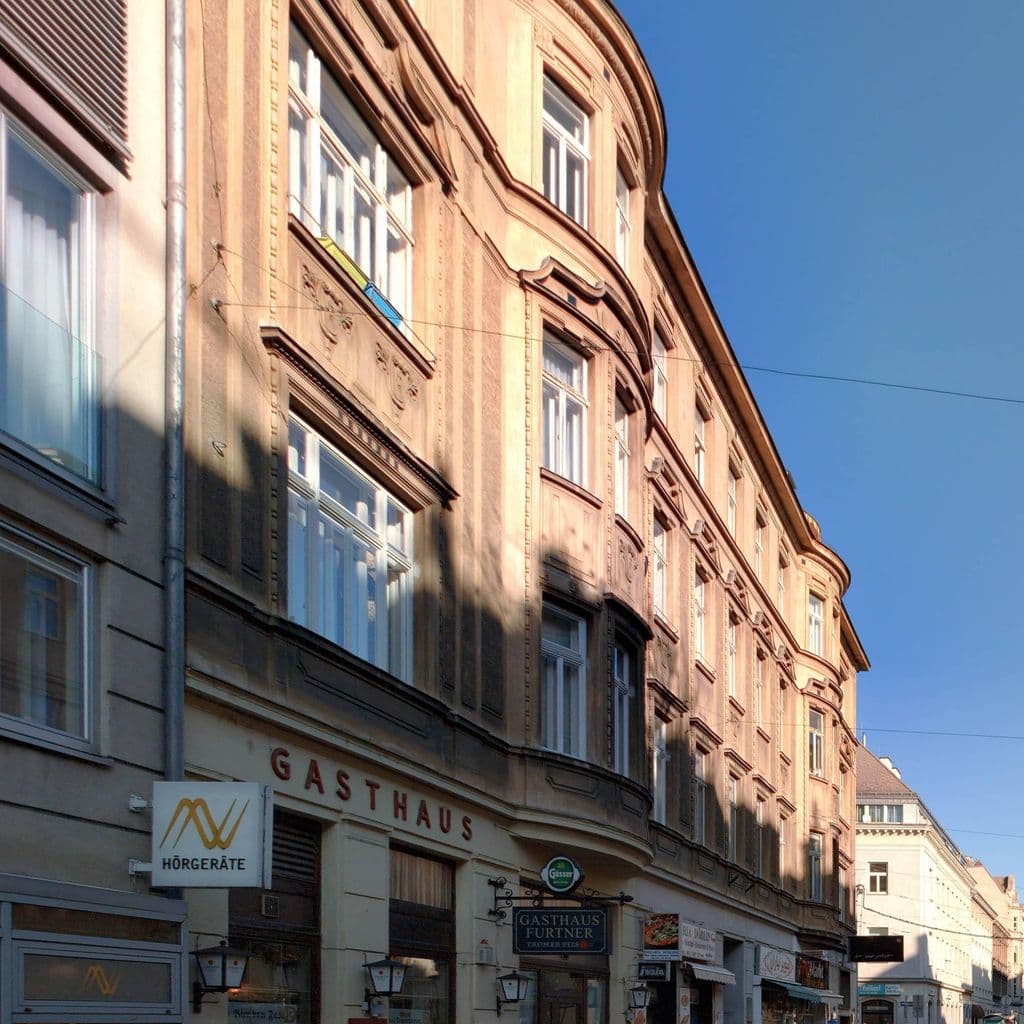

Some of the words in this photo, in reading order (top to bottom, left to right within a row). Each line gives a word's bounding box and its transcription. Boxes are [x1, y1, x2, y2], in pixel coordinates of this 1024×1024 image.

[271, 747, 473, 841] GASTHAUS
[162, 856, 246, 870] HÖRGERÄTE
[519, 914, 600, 926] GASTHAUS
[525, 927, 593, 939] FURTNER
